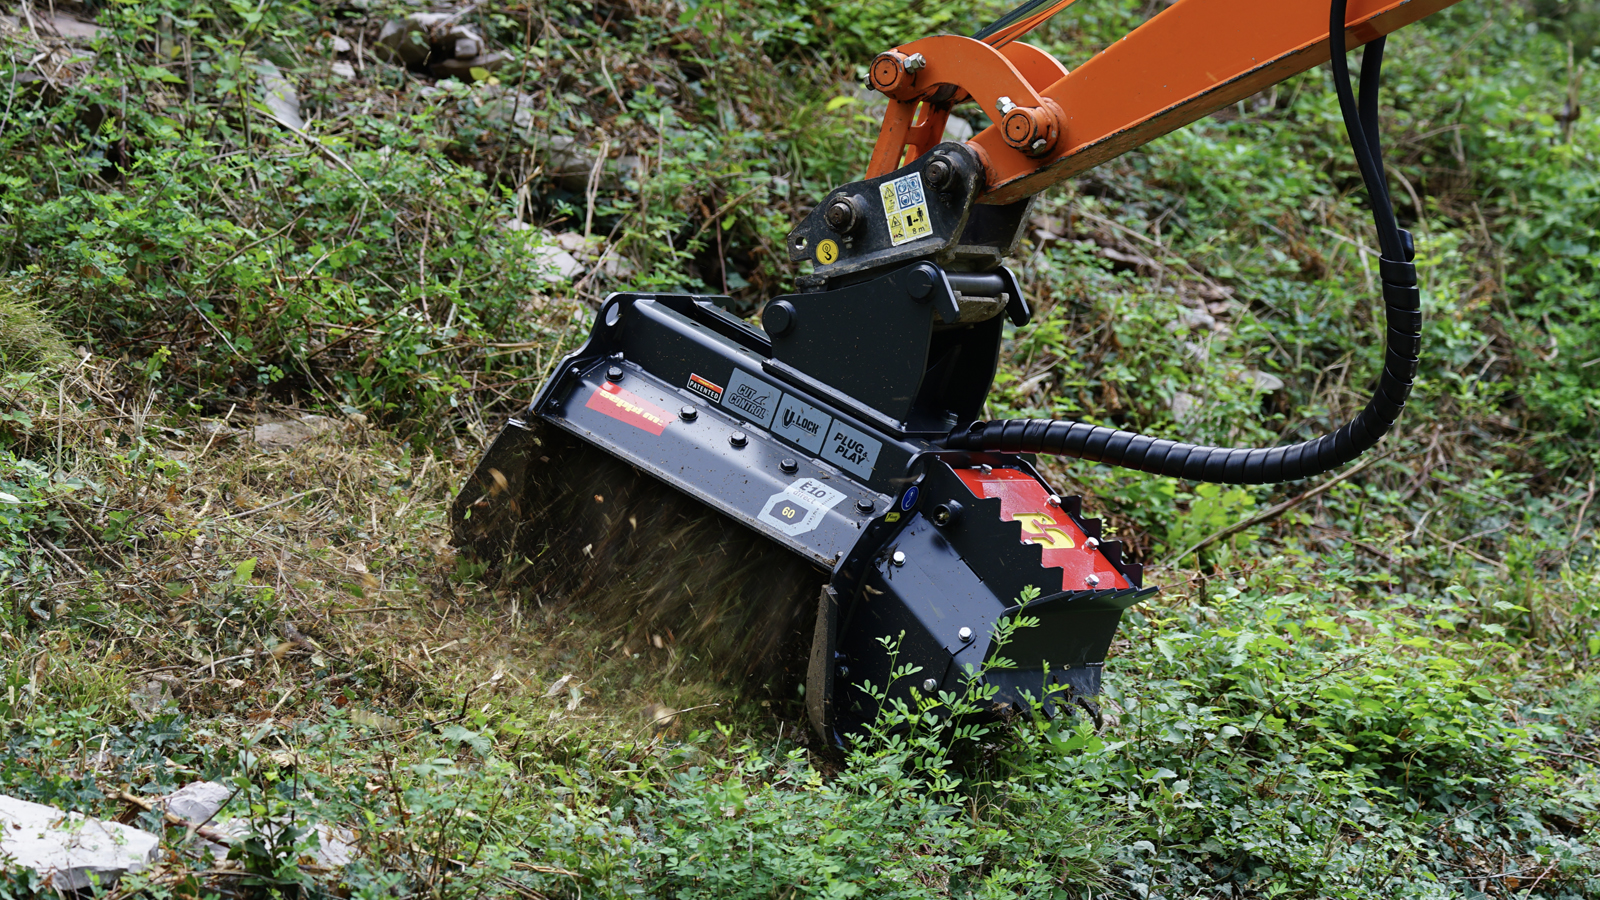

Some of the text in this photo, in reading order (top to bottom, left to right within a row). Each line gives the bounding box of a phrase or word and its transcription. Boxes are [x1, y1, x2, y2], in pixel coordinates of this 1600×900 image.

[689, 380, 719, 400] PATENTED
[737, 384, 757, 400] CUT
[600, 390, 645, 415] seppi
[728, 393, 767, 419] CONTROL
[833, 432, 865, 453] PLUG
[834, 445, 866, 465] PLAY
[799, 481, 827, 498] E10
[781, 506, 796, 519] 60
